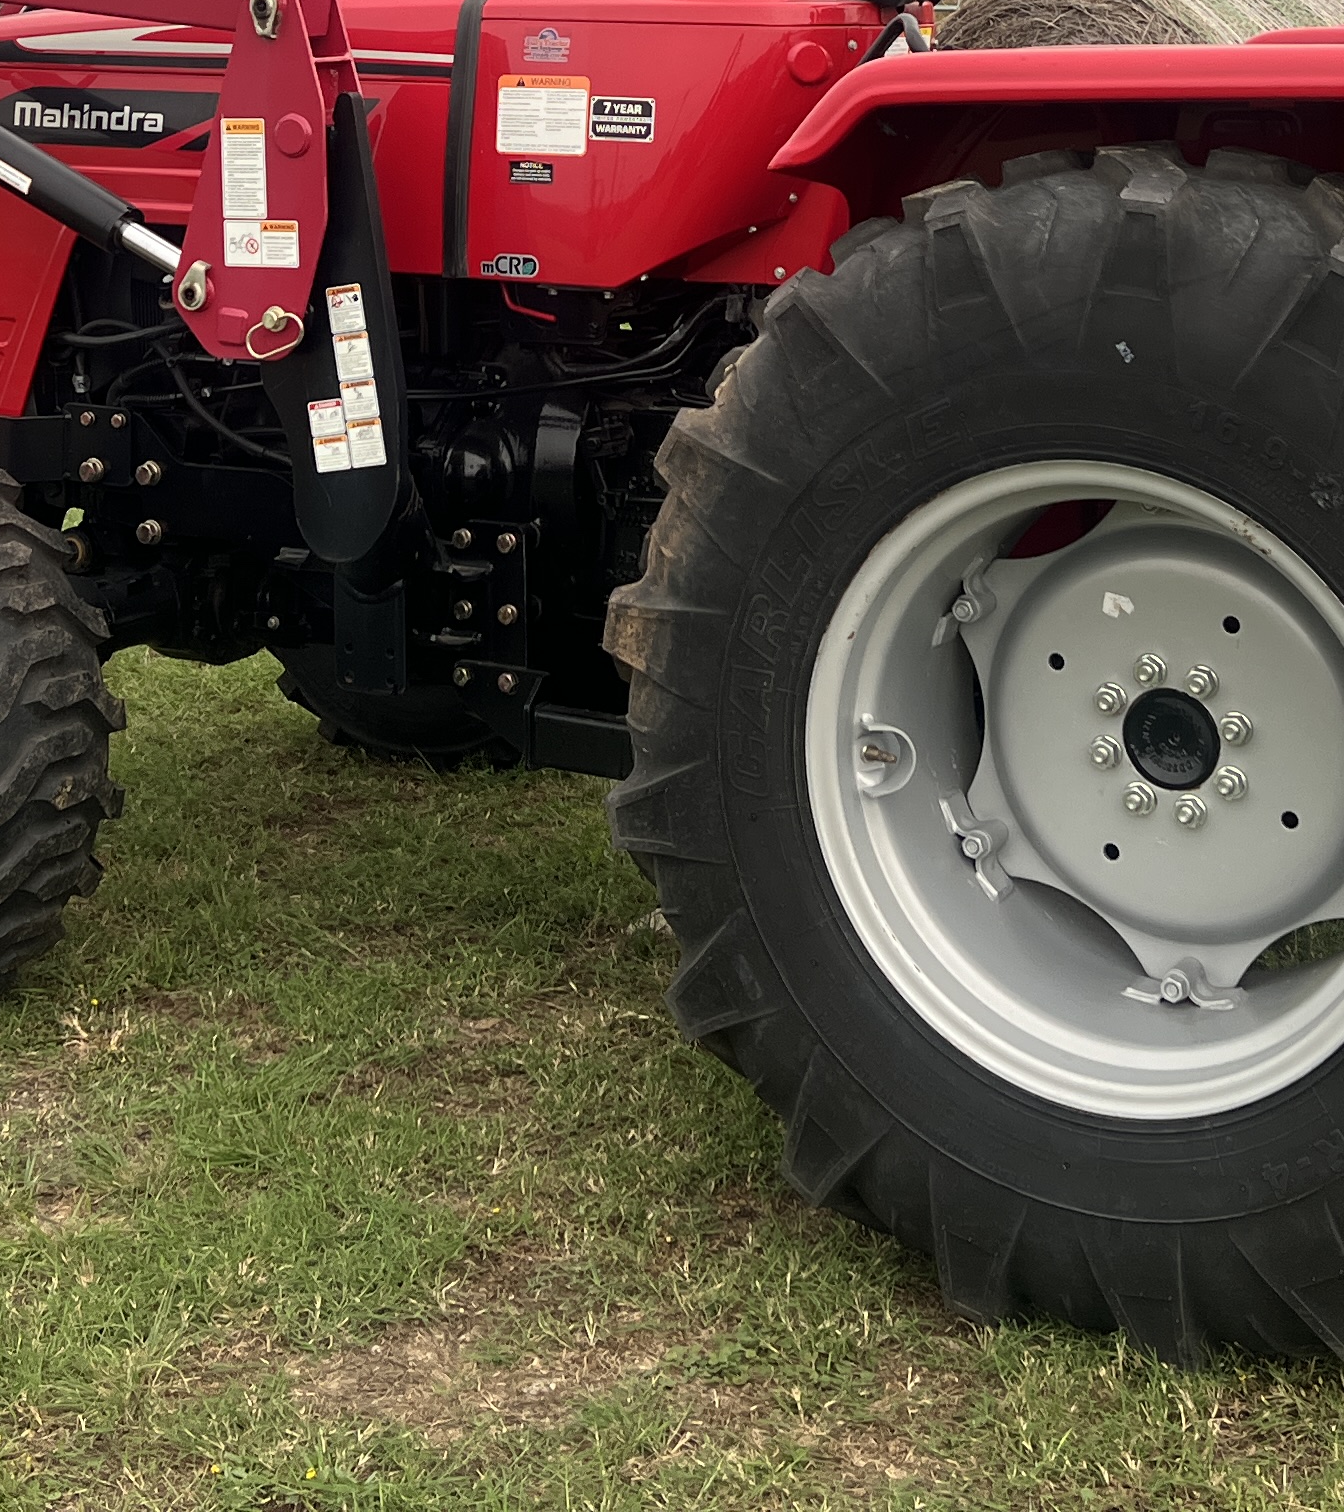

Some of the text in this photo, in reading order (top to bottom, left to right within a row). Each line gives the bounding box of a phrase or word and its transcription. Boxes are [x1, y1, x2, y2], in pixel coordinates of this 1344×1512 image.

[531, 77, 572, 87] WARNING
[602, 101, 643, 115] 7 YEAR
[13, 100, 164, 133] Mahindra
[595, 123, 648, 135] WARRANTY
[520, 162, 544, 170] NOTICE
[729, 397, 960, 798] CARLISLE
